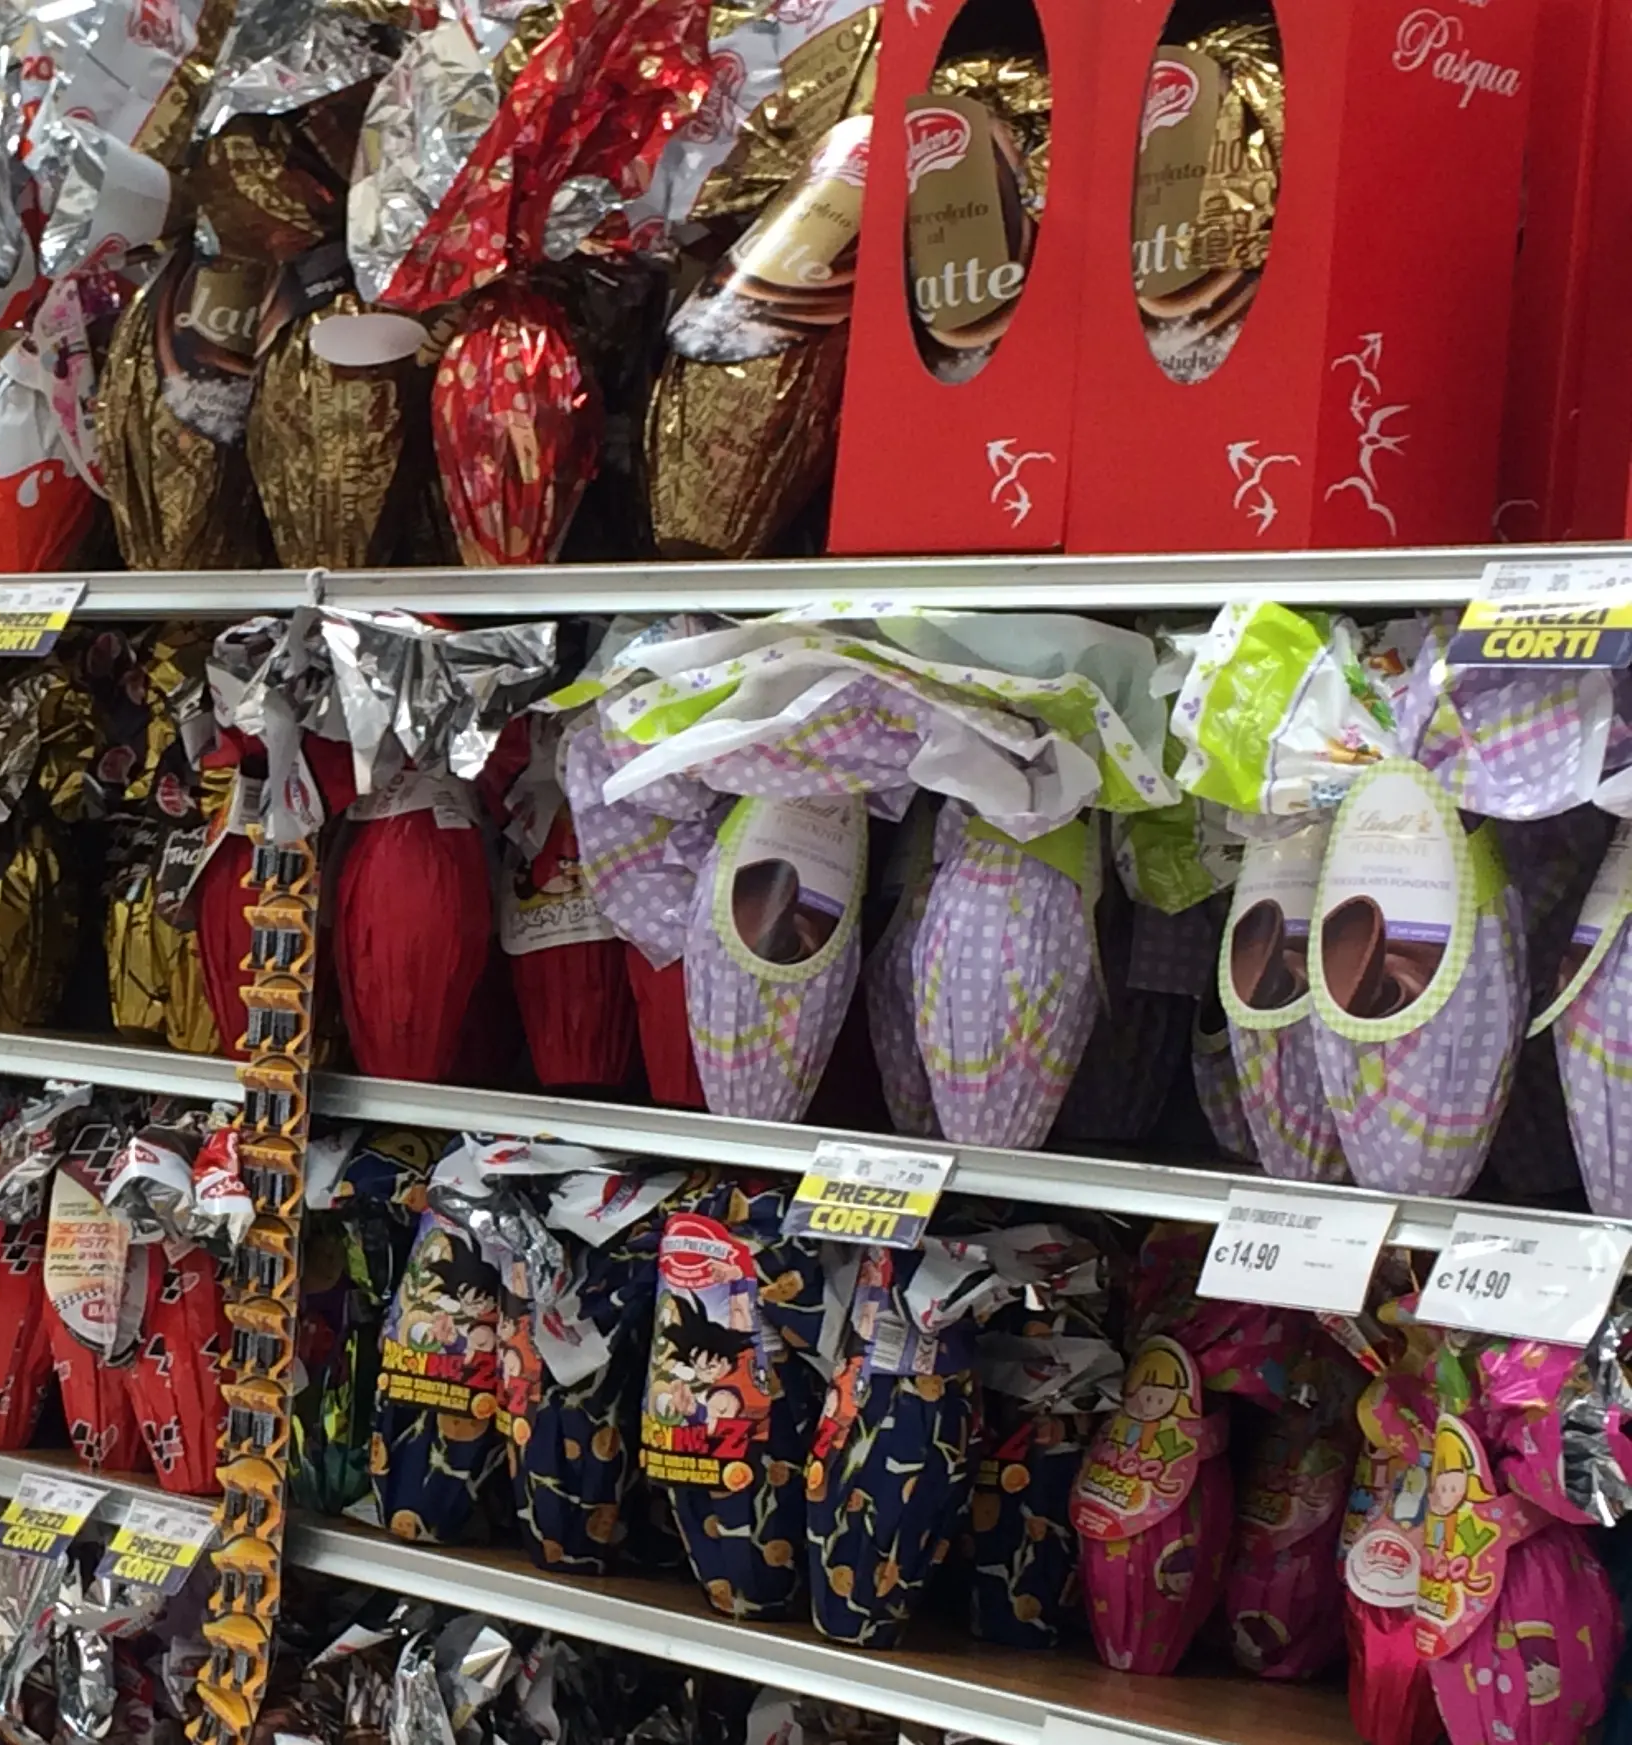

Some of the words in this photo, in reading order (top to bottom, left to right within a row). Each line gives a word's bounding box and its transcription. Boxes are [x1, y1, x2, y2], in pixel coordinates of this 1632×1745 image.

[1392, 8, 1522, 108] Pasqua
[916, 257, 1025, 323] atte
[174, 286, 259, 342] Lat
[1482, 629, 1602, 660] CORTI
[1355, 809, 1416, 833] Lindt
[820, 1181, 911, 1208] PREZZI
[808, 1206, 900, 1239] CORTI
[710, 1416, 753, 1459] Z
[17, 1507, 69, 1528] PREZZI
[1, 1526, 58, 1553] CORTI
[129, 1535, 181, 1560] PREZZI
[113, 1556, 170, 1586] CORTI
